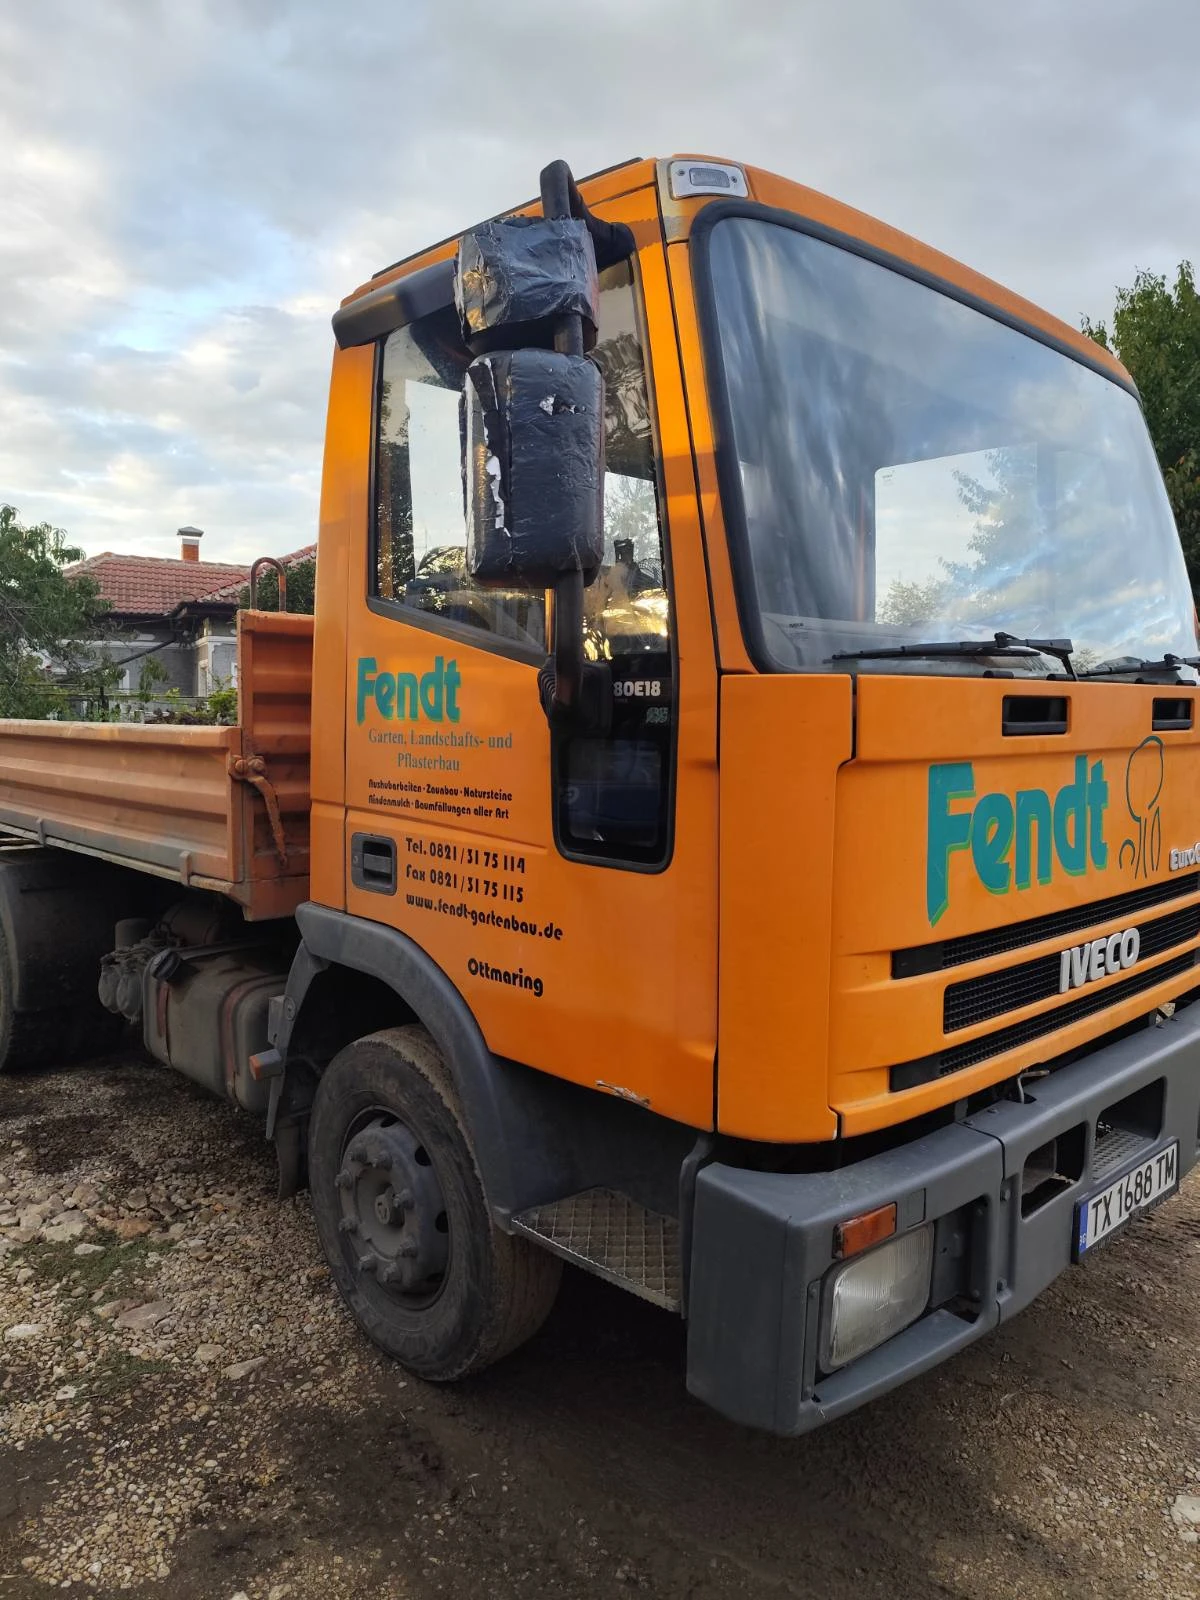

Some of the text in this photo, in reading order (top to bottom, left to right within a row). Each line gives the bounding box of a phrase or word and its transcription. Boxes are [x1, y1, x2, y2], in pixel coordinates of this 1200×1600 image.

[356, 655, 461, 727] Fendt
[368, 728, 513, 749] Garten, Landschafts- und
[397, 752, 460, 771] Pflasterbau
[426, 784, 459, 796] Zaunbau
[463, 786, 513, 801] Natursteine
[473, 806, 493, 818] aller
[495, 807, 509, 819] Art
[406, 837, 427, 856] Tel.
[484, 852, 499, 869] 75
[503, 855, 526, 874] 114
[926, 754, 1109, 928] Fendt
[406, 864, 426, 882] Fax
[484, 880, 498, 898] 75
[503, 884, 524, 903] 115
[406, 894, 564, 940] www.fendt-gartenbau.de
[467, 957, 544, 998] Ottmaring
[1059, 928, 1141, 994] IVECO
[1092, 1148, 1175, 1238] TX 1688 TM
